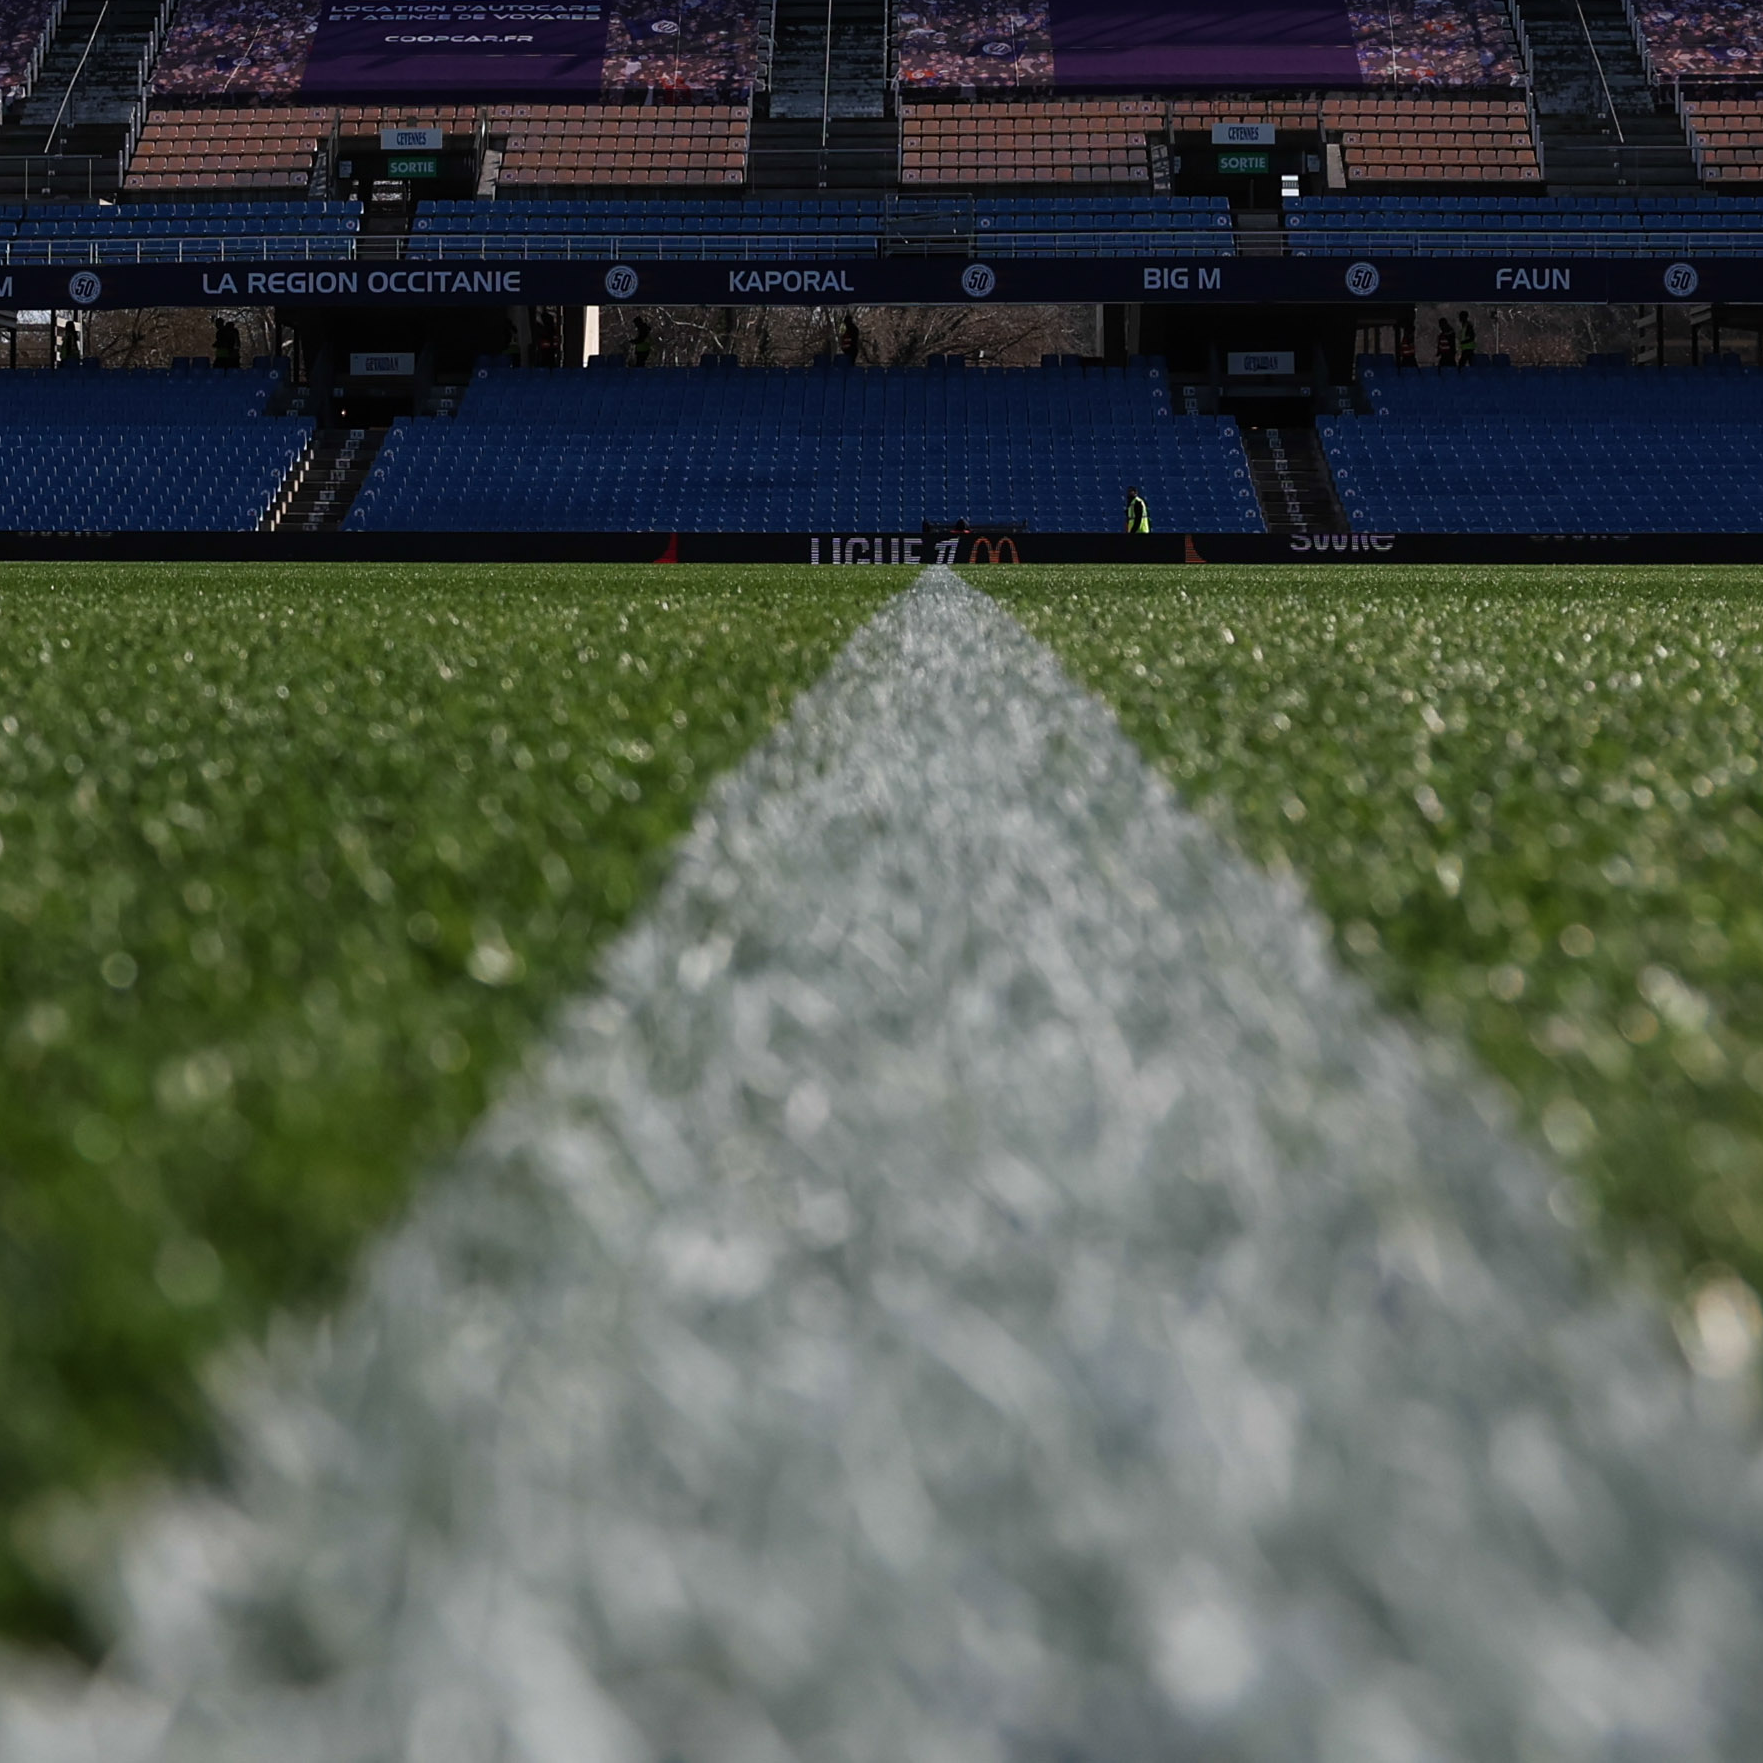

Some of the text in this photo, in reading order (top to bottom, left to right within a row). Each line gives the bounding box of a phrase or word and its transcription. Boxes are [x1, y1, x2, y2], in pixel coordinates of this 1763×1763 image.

[330, 3, 602, 14] LOCATION D'AUTOCARS
[328, 12, 601, 22] ET AGENCE DE VOYAGES
[384, 34, 534, 44] COOPCAR.FR
[396, 132, 427, 145] CEVENNES
[1228, 126, 1259, 140] CEVENNES
[390, 162, 434, 173] SORTIE
[1221, 157, 1266, 169] SORTIE
[202, 270, 522, 294] LA REGION OCCITANIE
[729, 269, 855, 293] KAPORAL
[1143, 268, 1222, 290] BIG M
[1496, 267, 1570, 291] FAUN
